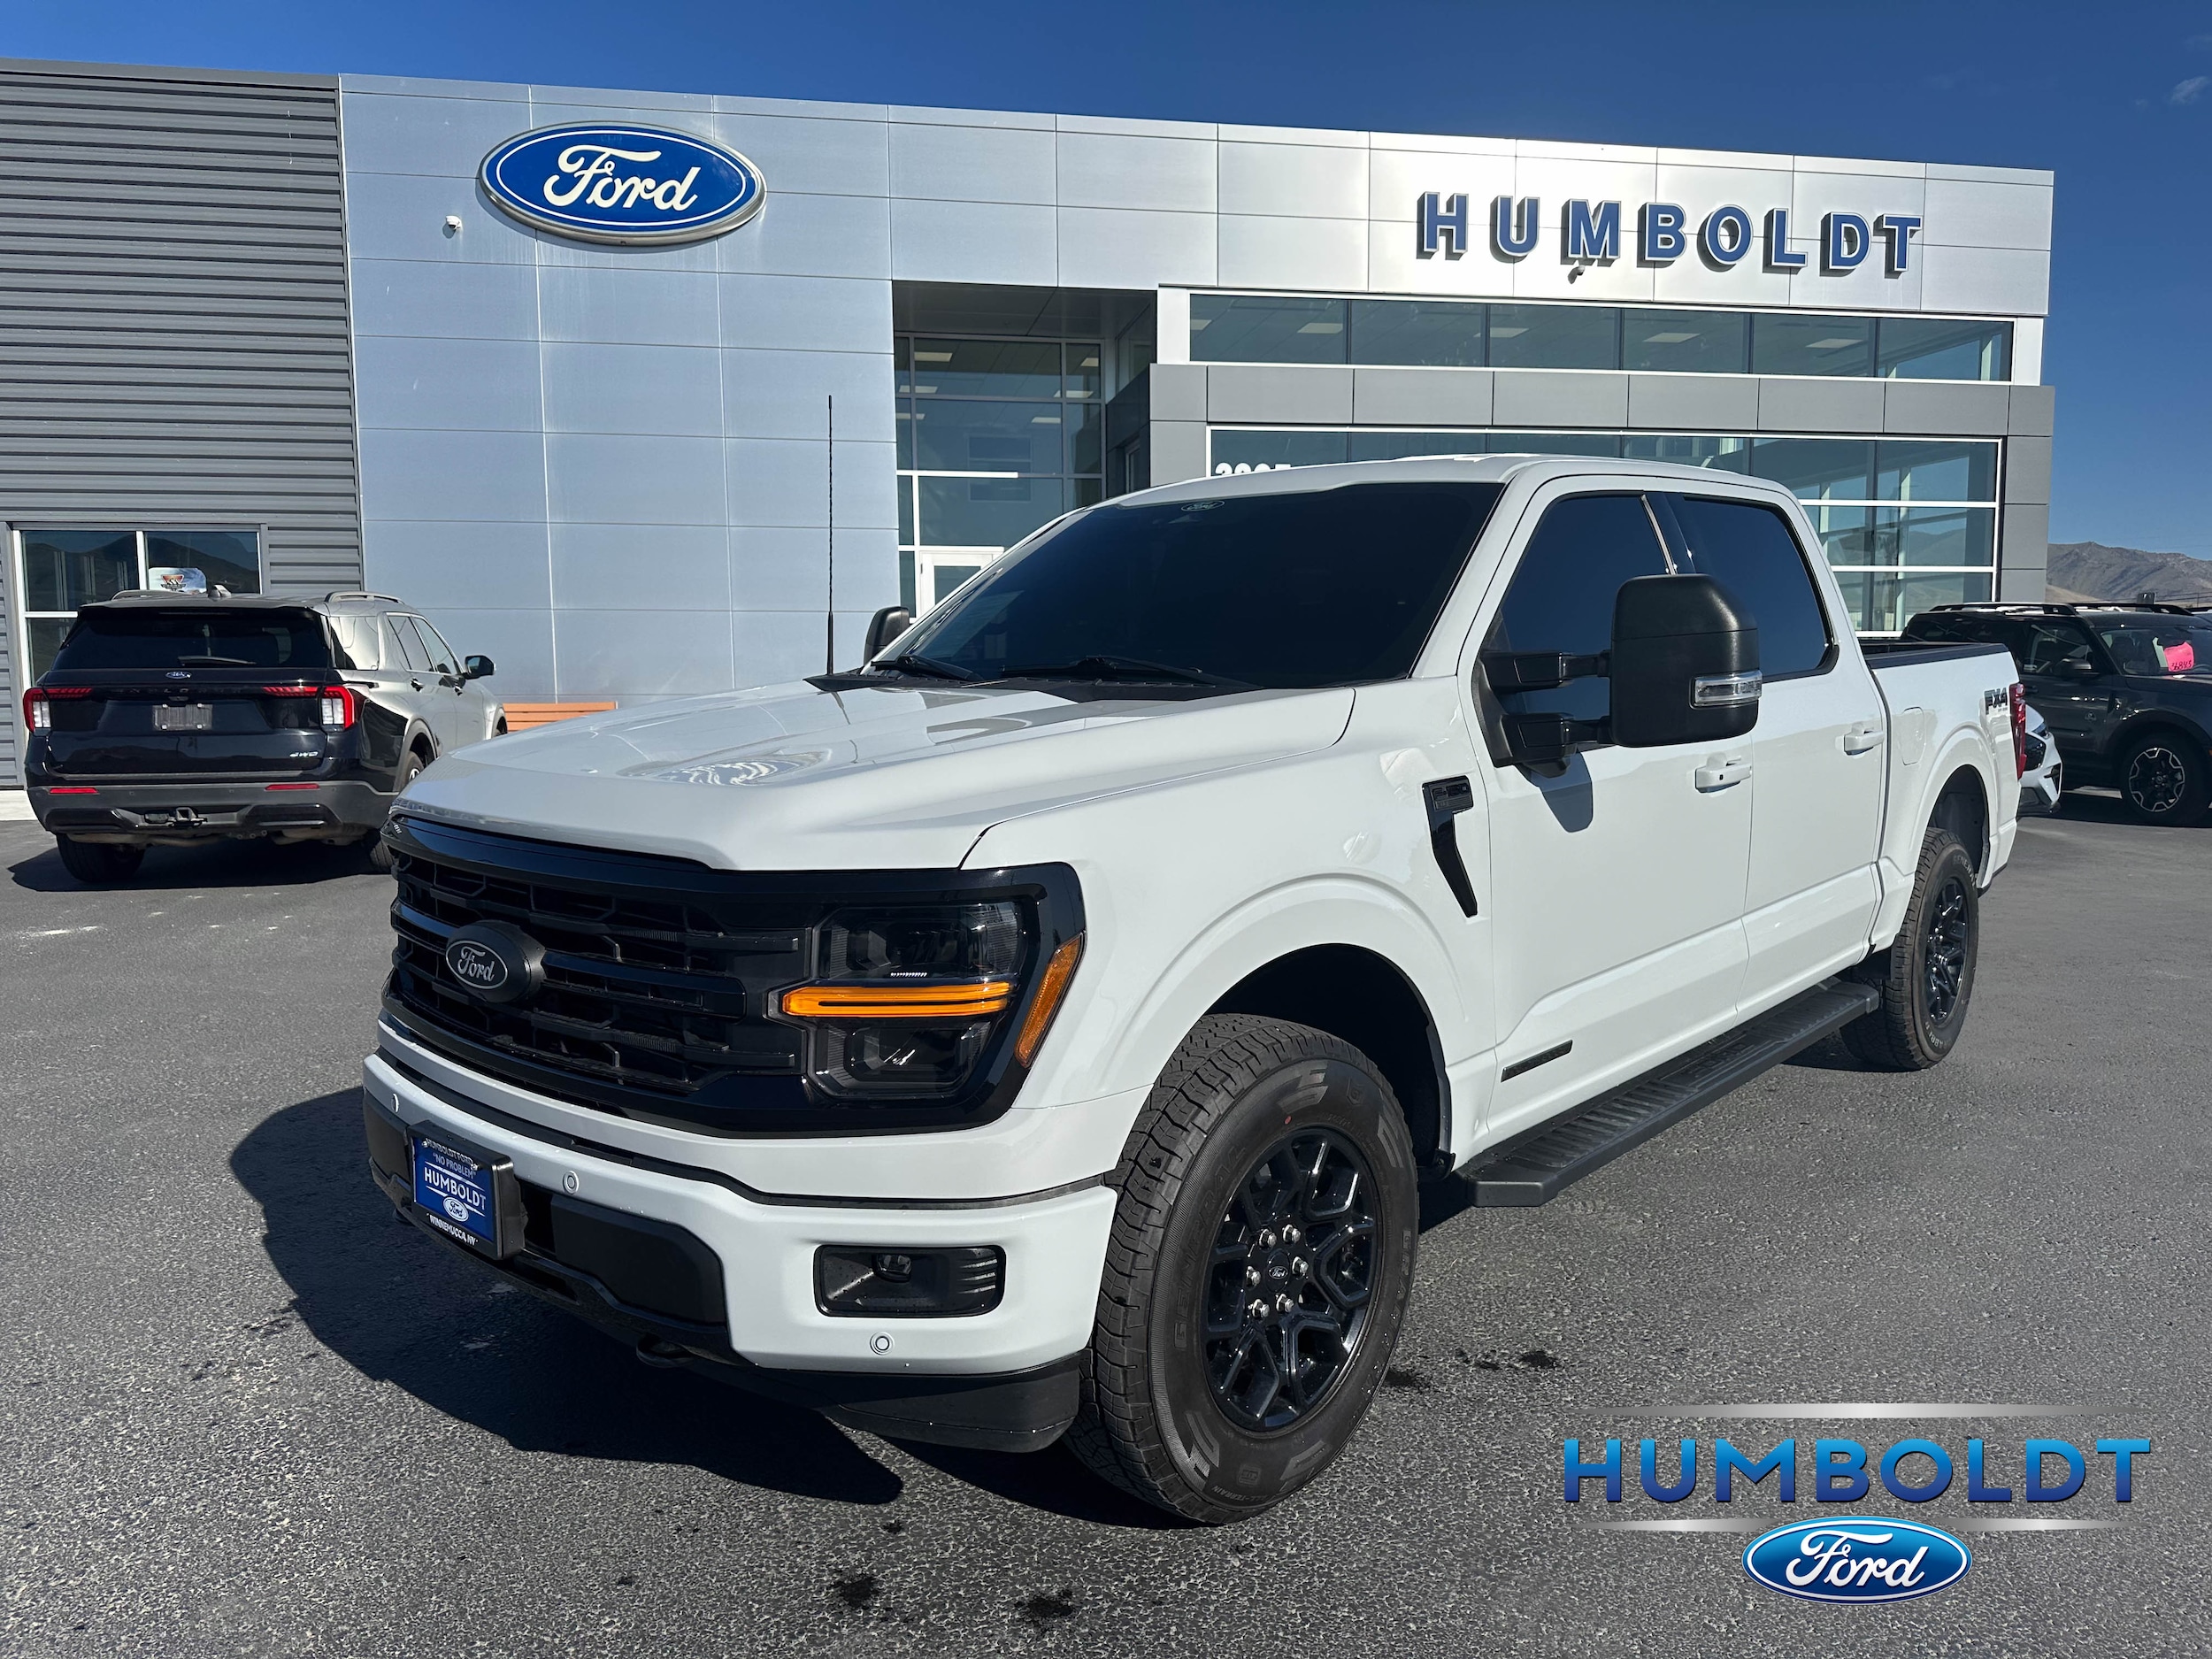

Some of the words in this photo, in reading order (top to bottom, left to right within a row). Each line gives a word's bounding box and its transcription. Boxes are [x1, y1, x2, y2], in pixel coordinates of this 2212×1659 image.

[542, 143, 702, 211] Ford
[1418, 191, 1924, 275] HUMBOLDT
[1984, 687, 2008, 715] FX4
[457, 946, 495, 982] Ford
[425, 1166, 486, 1210] HUMBOLDT
